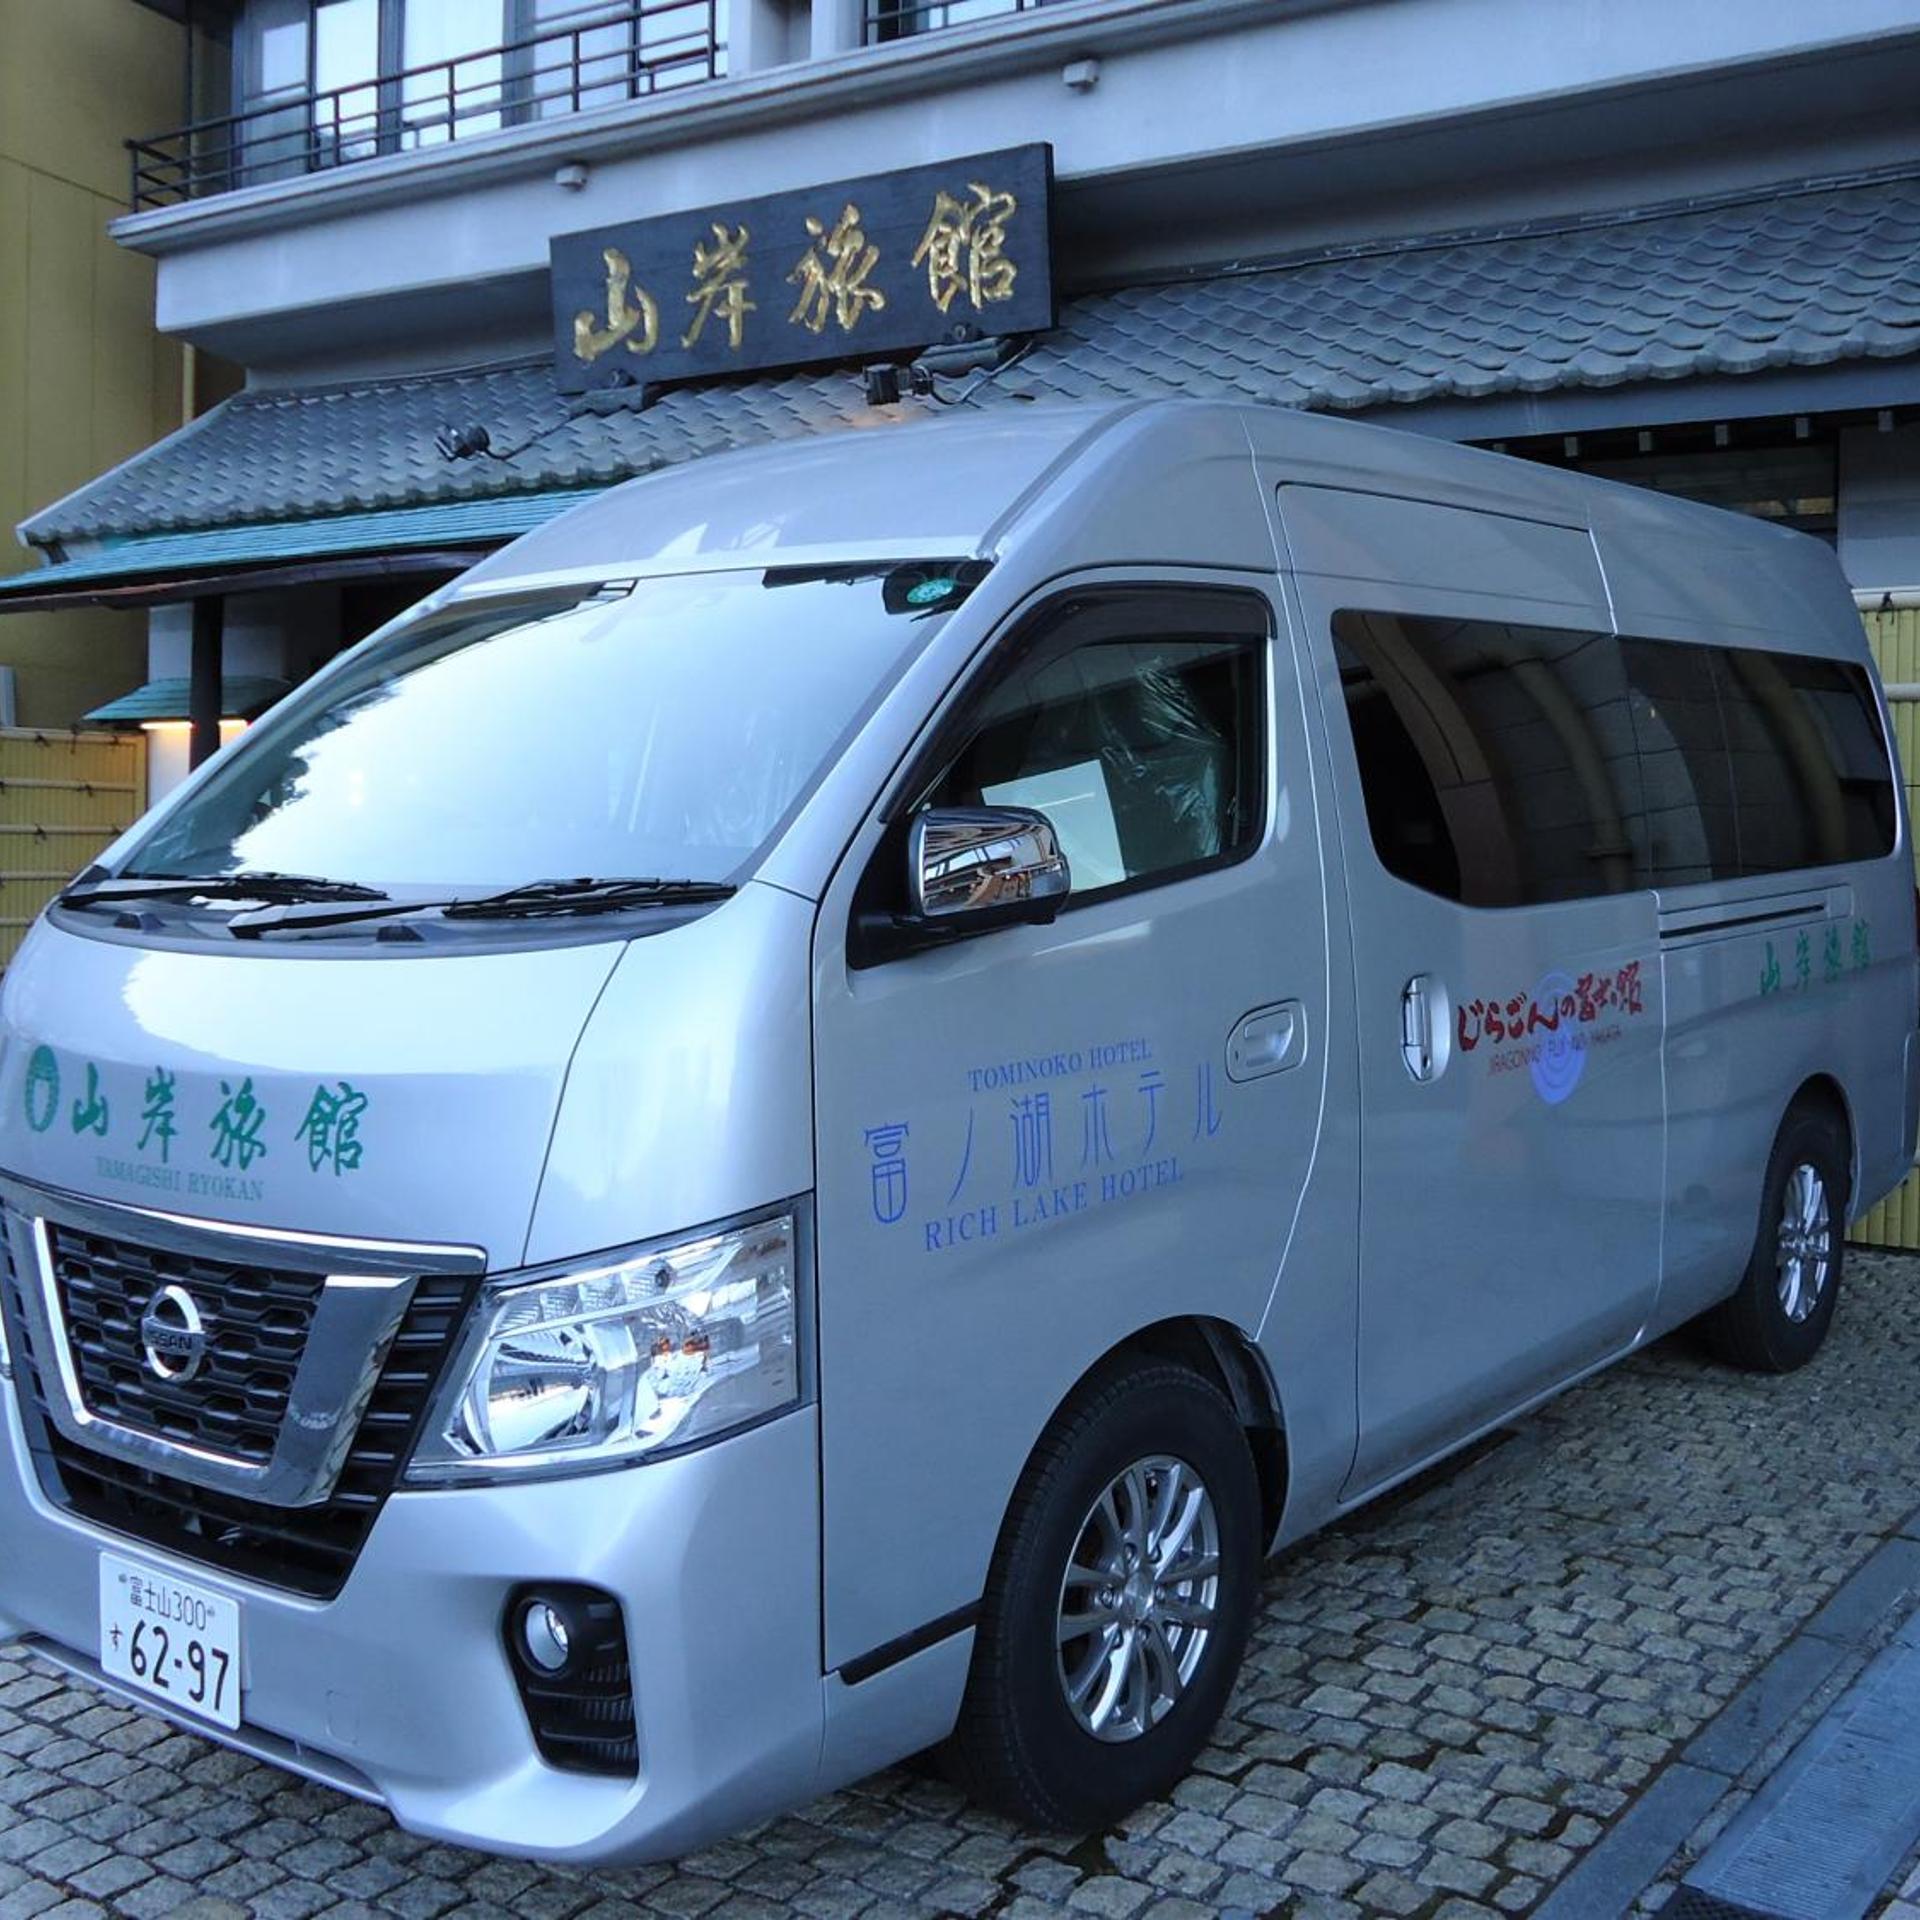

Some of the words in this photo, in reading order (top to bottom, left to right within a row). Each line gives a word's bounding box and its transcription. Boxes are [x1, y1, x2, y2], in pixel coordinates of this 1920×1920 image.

[574, 180, 1017, 361] 山岸旅館
[967, 1052, 1082, 1092] TOMINOKO
[1090, 1037, 1152, 1067] HOTEL
[72, 1061, 368, 1176] 山岸旅館
[188, 1172, 265, 1201] RYOKAN
[925, 1205, 997, 1252] RICH
[1014, 1181, 1088, 1228] LAKE
[1102, 1157, 1184, 1202] HOTEL
[130, 1619, 229, 1712] 62-97
